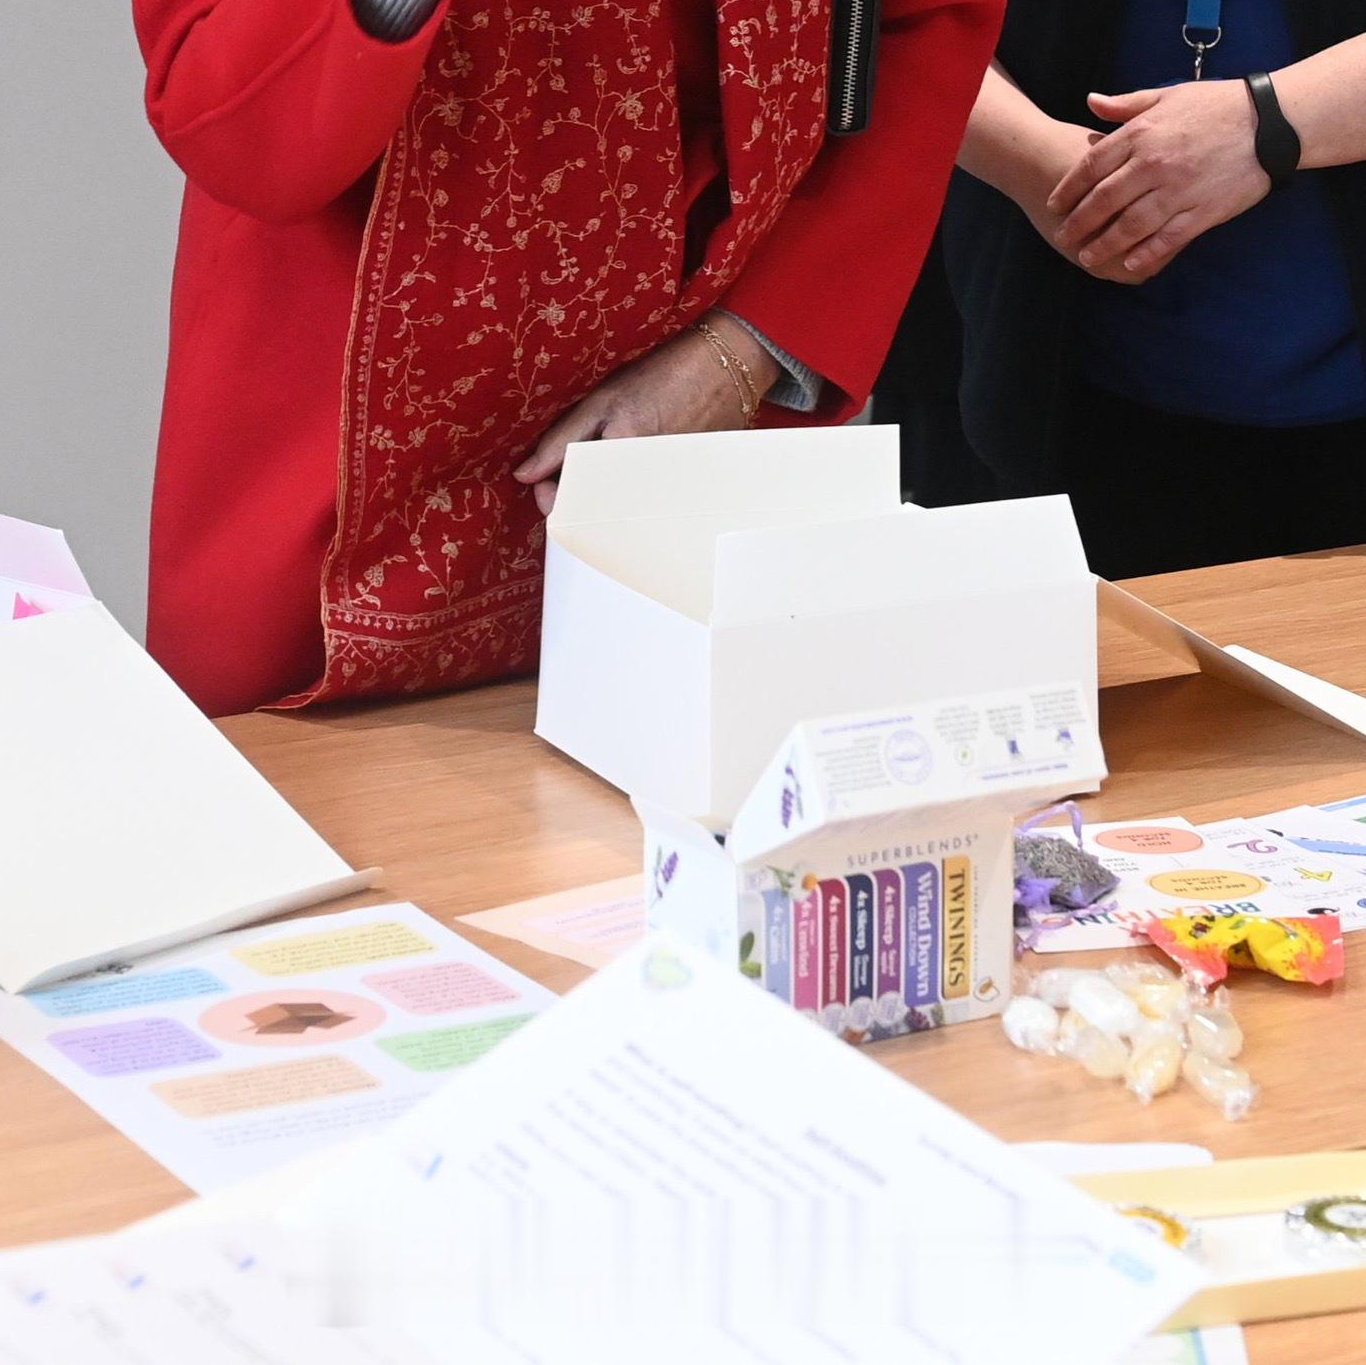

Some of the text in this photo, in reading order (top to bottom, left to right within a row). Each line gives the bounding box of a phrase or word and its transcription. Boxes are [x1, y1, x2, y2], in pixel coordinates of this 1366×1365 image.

[847, 835, 974, 867] SUPERBLENDS
[1227, 839, 1278, 855] 2
[857, 889, 869, 908] 4x
[883, 885, 896, 903] 4x
[1173, 882, 1247, 894] BREATHE IN
[828, 895, 842, 913] 4x
[855, 909, 867, 950] Sleep
[882, 904, 895, 946] Sleep
[916, 870, 933, 998] Wind Down
[948, 869, 965, 987] TWININGS
